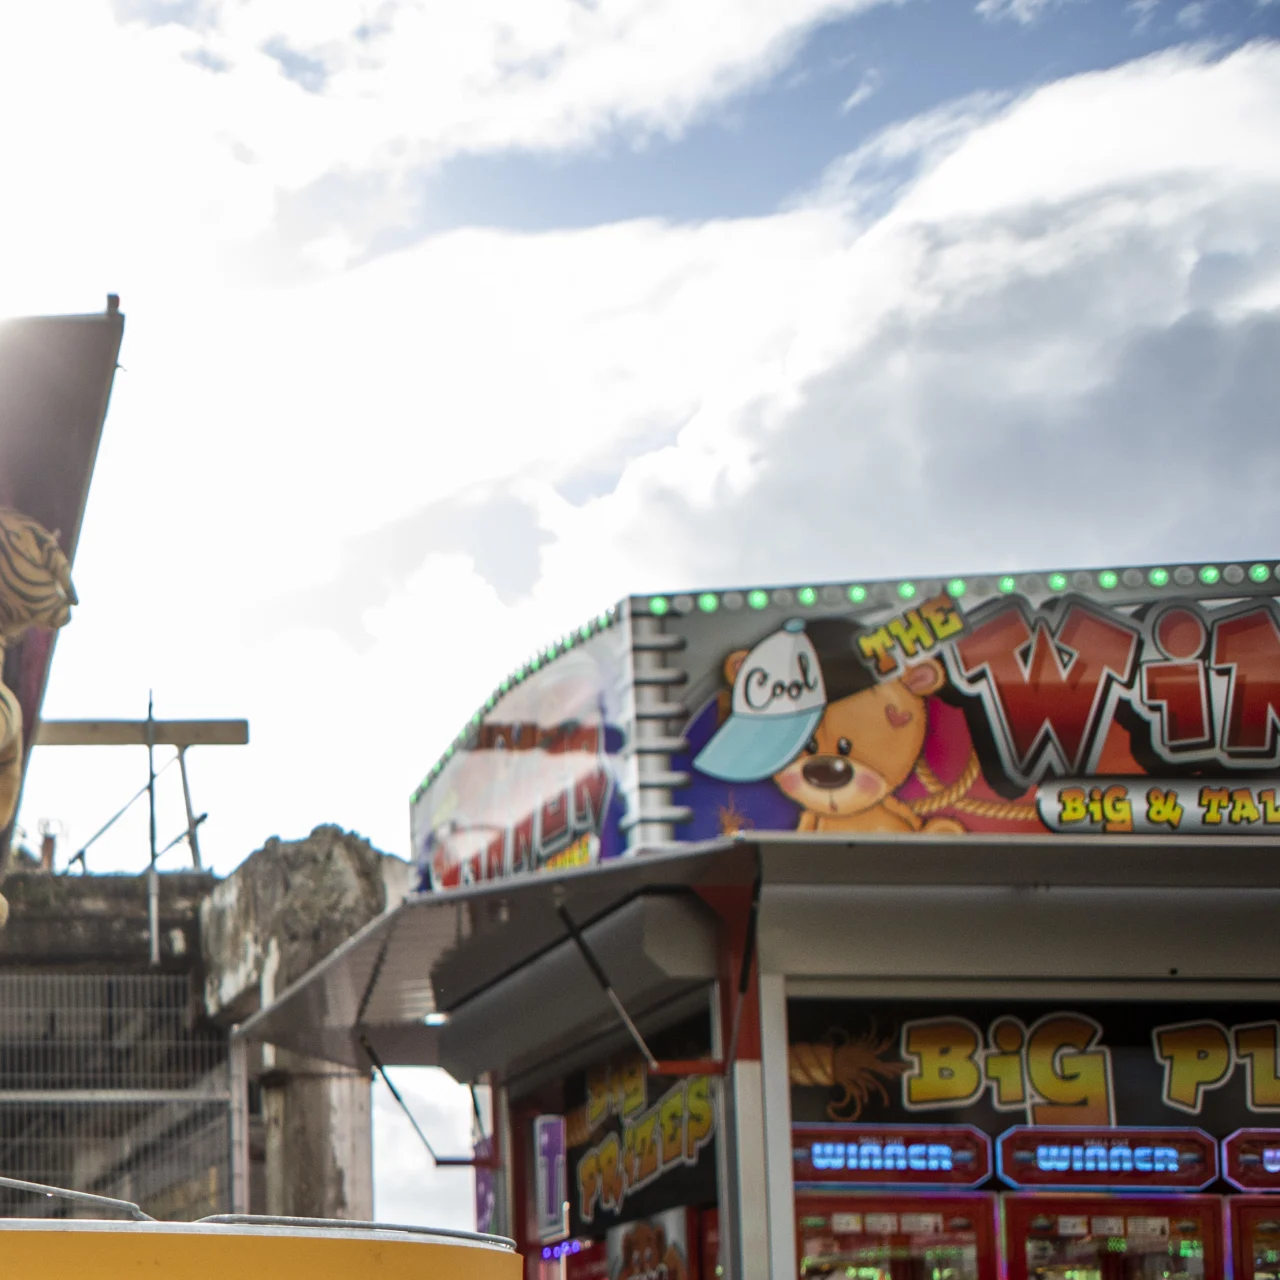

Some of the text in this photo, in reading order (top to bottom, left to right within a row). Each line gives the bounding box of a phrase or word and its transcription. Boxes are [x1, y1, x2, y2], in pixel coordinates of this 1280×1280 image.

[859, 599, 965, 674] THE
[744, 653, 818, 710] Cool
[1059, 788, 1133, 832] BiG
[1147, 789, 1184, 825] &
[904, 1012, 1114, 1126] BiG
[811, 1143, 953, 1171] WINNER
[1037, 1145, 1179, 1173] WINNER
